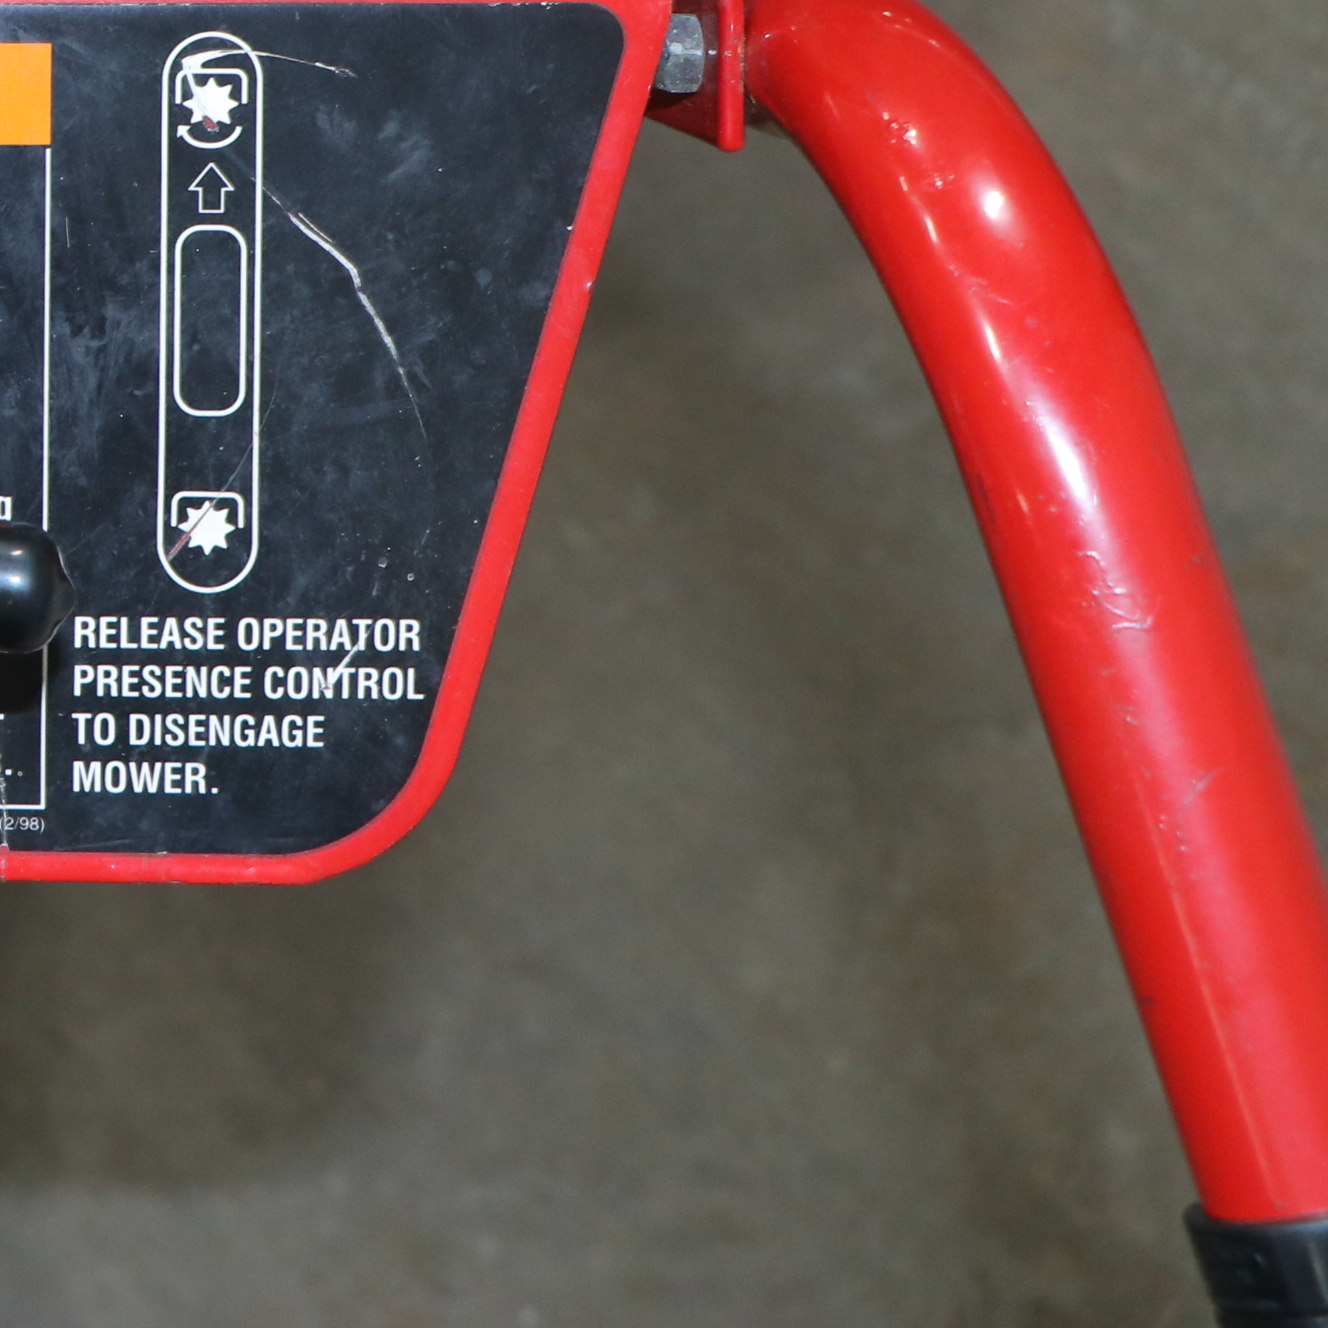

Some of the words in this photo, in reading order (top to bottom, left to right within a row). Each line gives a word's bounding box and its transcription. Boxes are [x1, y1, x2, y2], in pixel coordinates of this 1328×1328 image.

[73, 615, 226, 650] RELEASE
[237, 616, 421, 652] OPERATOR
[73, 664, 252, 699] PRESENCE
[263, 665, 425, 700] CONTROL
[71, 712, 116, 746] TO
[129, 713, 325, 748] DISENGAGE
[72, 760, 219, 794] MOWER.
